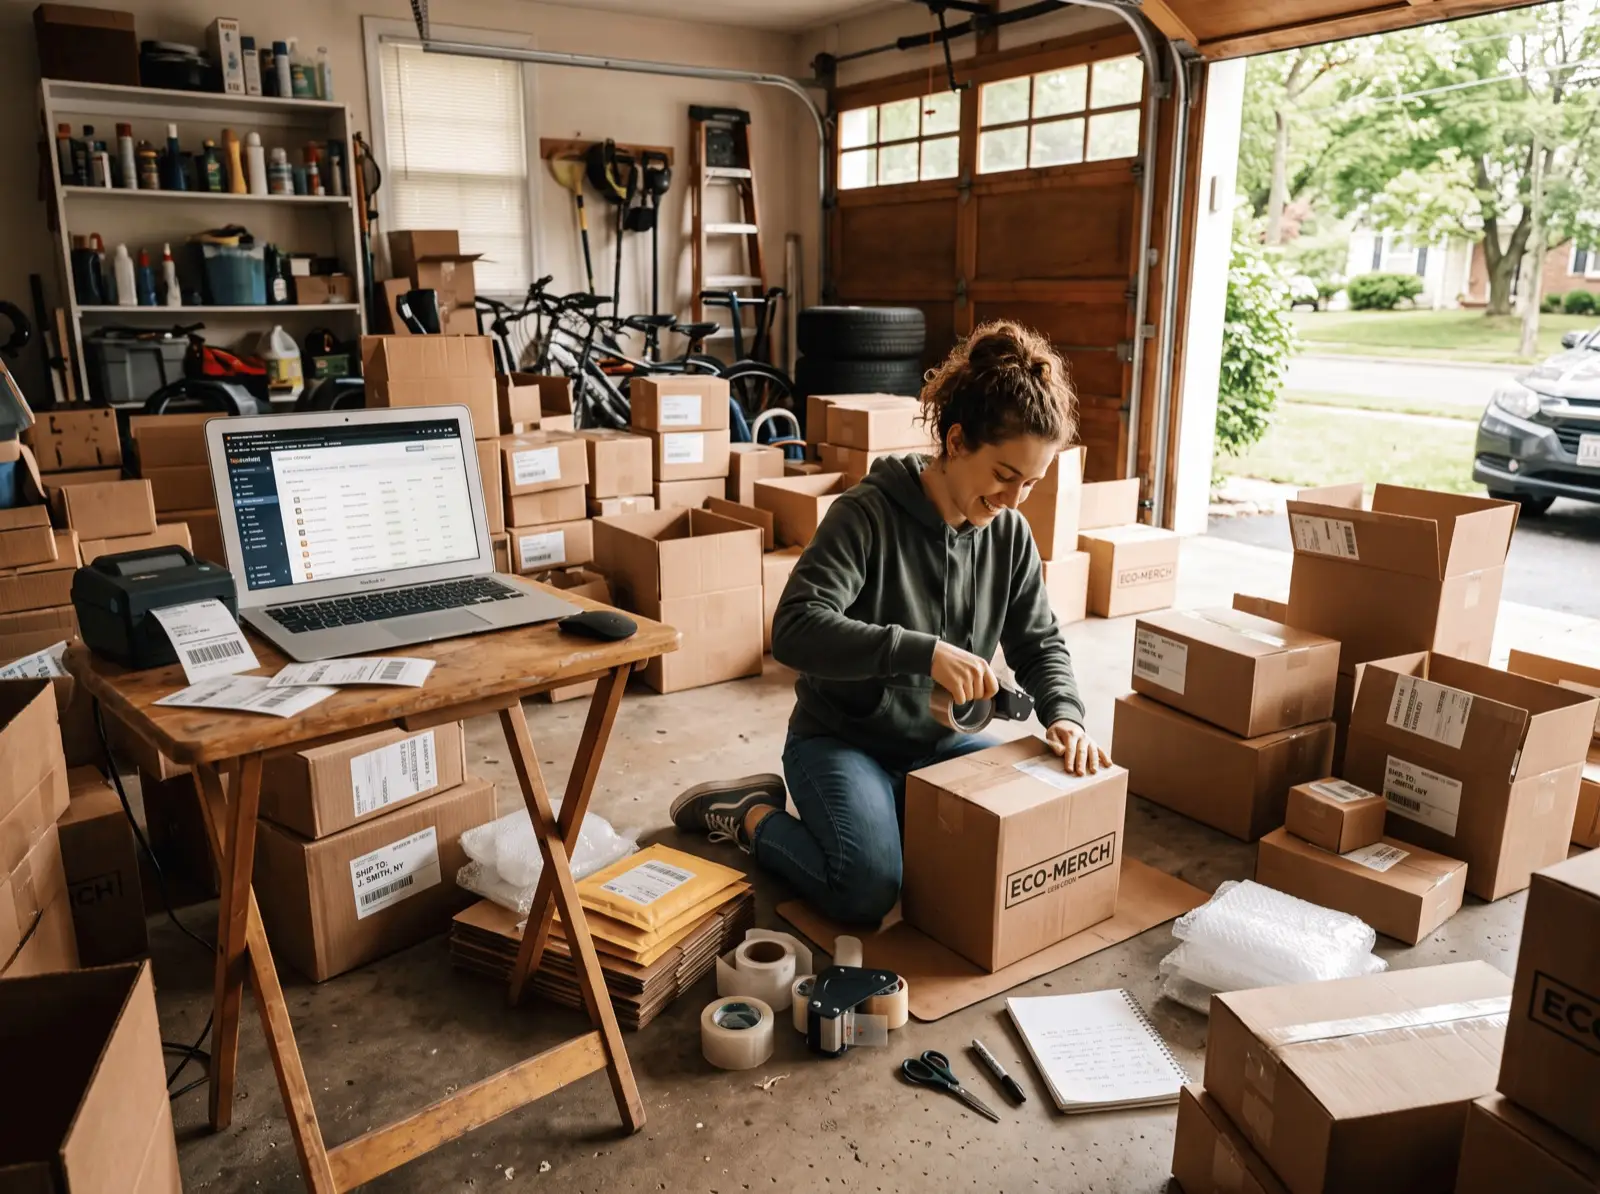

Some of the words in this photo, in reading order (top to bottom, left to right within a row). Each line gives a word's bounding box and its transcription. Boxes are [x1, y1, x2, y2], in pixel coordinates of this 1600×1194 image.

[1119, 566, 1173, 585] ECO-MERCH
[355, 865, 374, 879] SHIP
[375, 860, 388, 870] TO:
[357, 879, 365, 888] J.
[366, 868, 393, 884] SMITH,
[393, 861, 405, 873] NY
[1011, 841, 1111, 899] ECO-MERCH
[70, 881, 113, 908] CH
